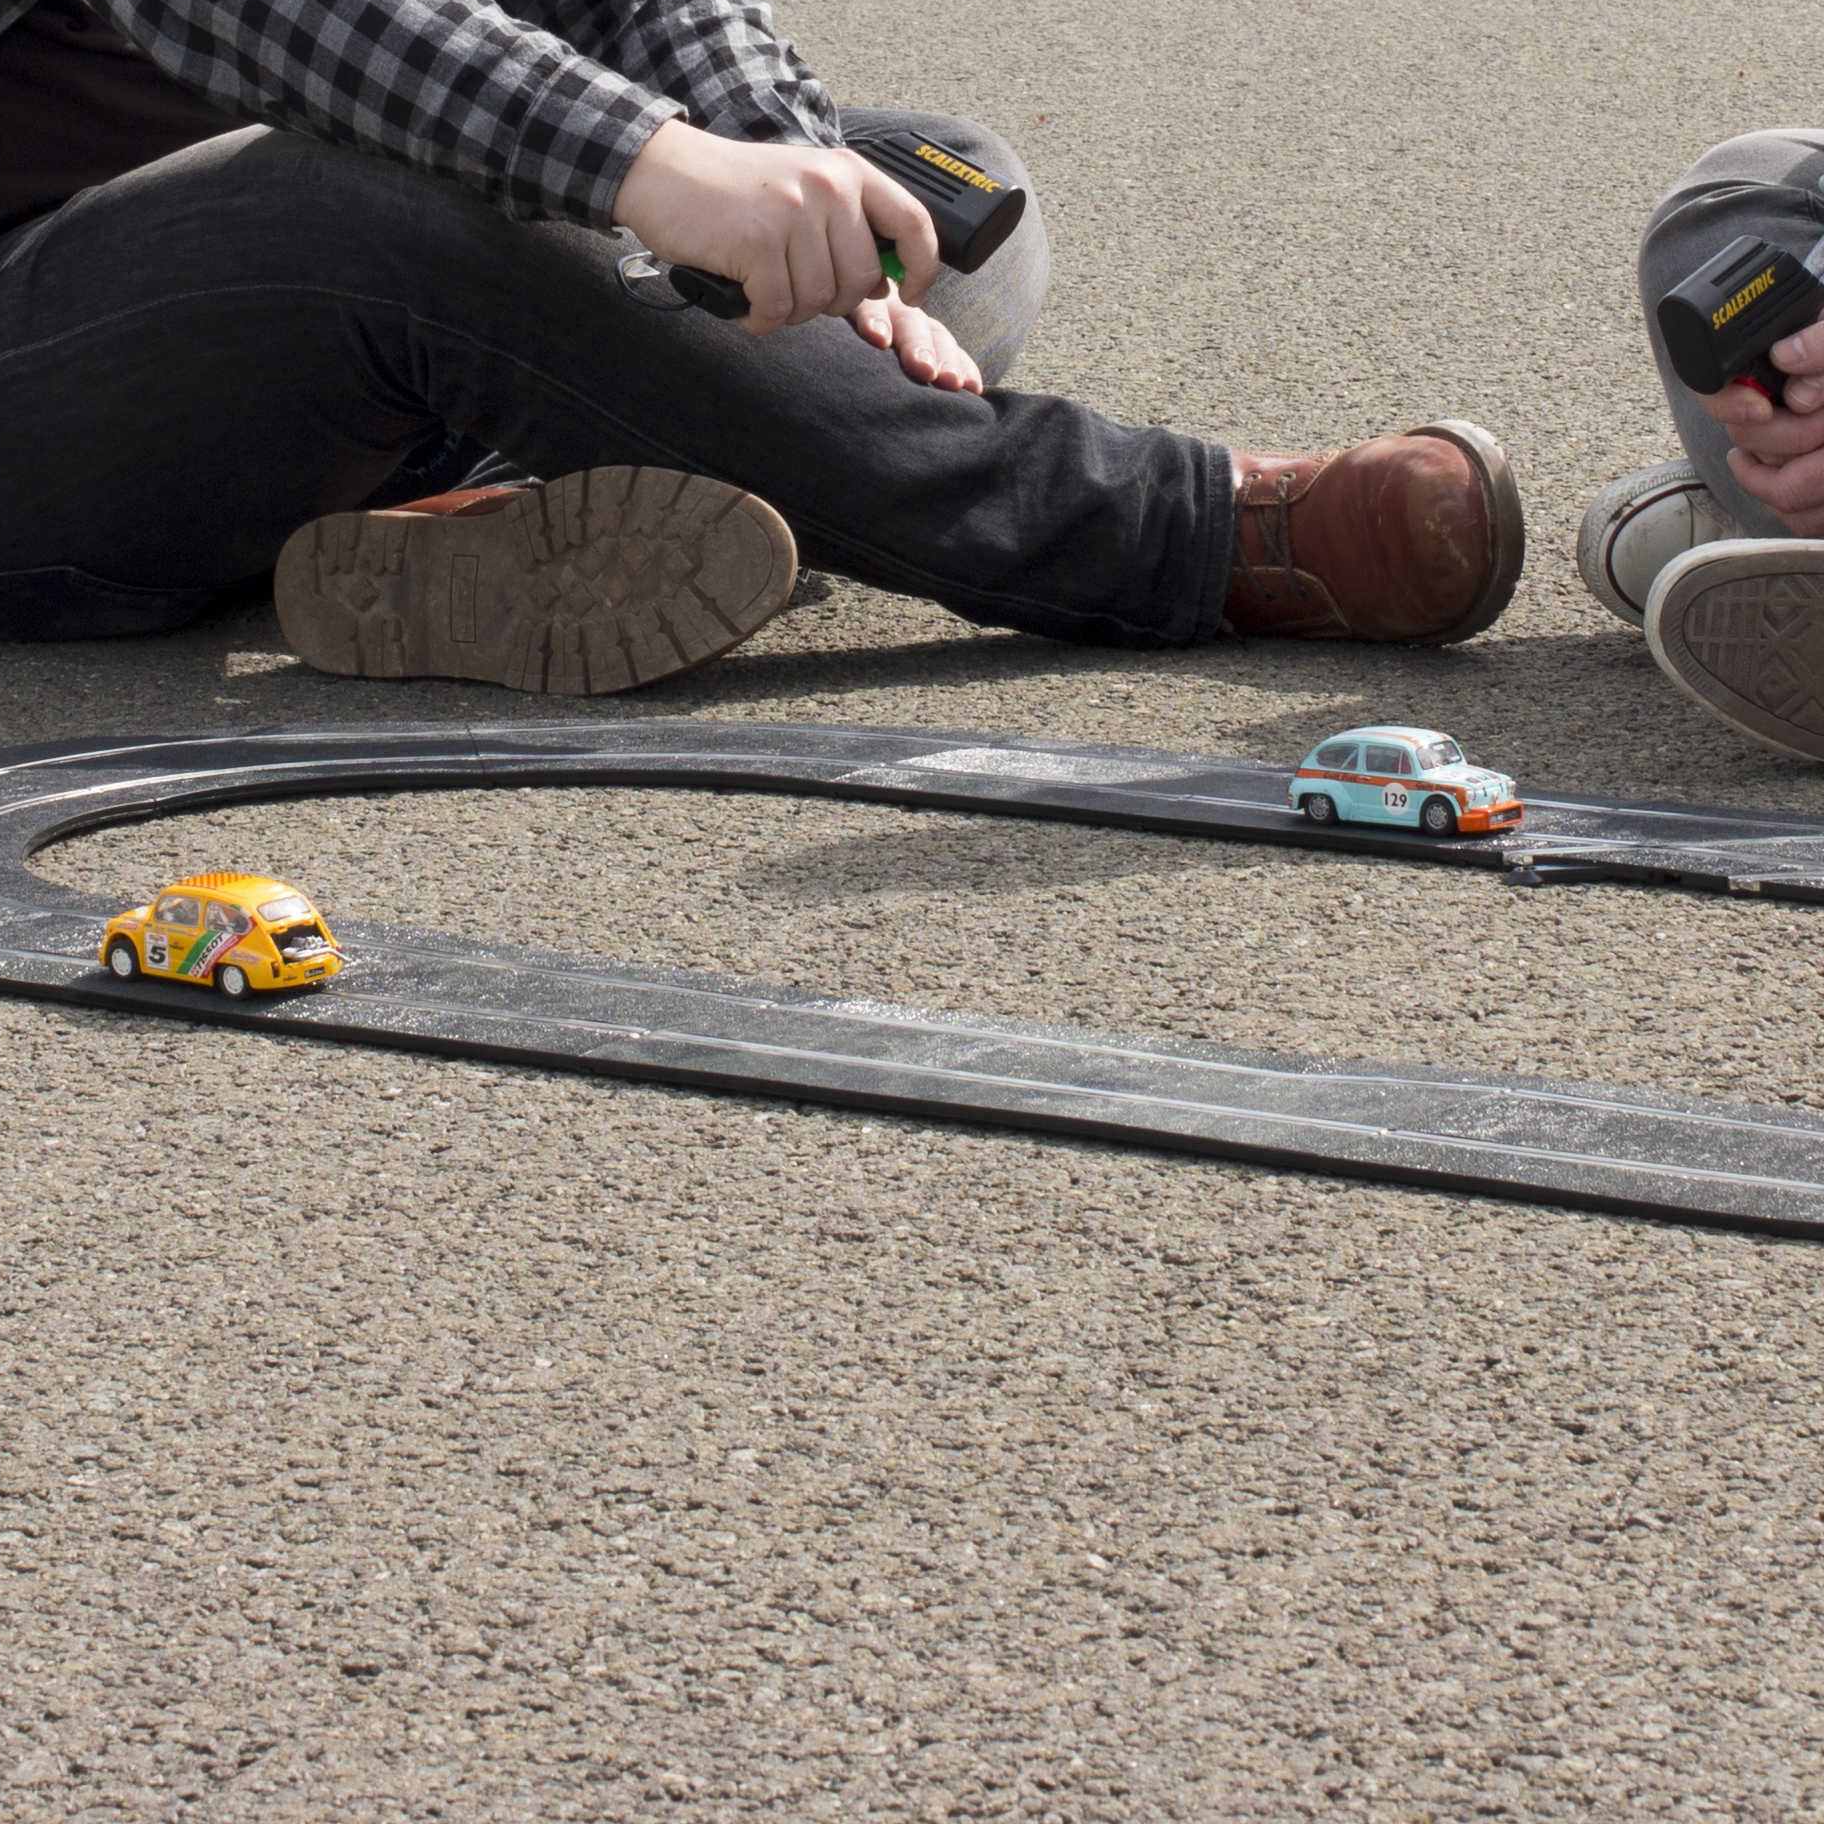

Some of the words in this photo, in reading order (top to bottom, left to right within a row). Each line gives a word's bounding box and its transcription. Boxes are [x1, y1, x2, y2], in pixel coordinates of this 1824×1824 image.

[914, 144, 1001, 193] SCALEXTRIC
[1712, 268, 1776, 331] SCALEXTRIC
[1384, 791, 1408, 808] 129
[148, 945, 167, 964] 5
[197, 932, 225, 971] TISSOT
